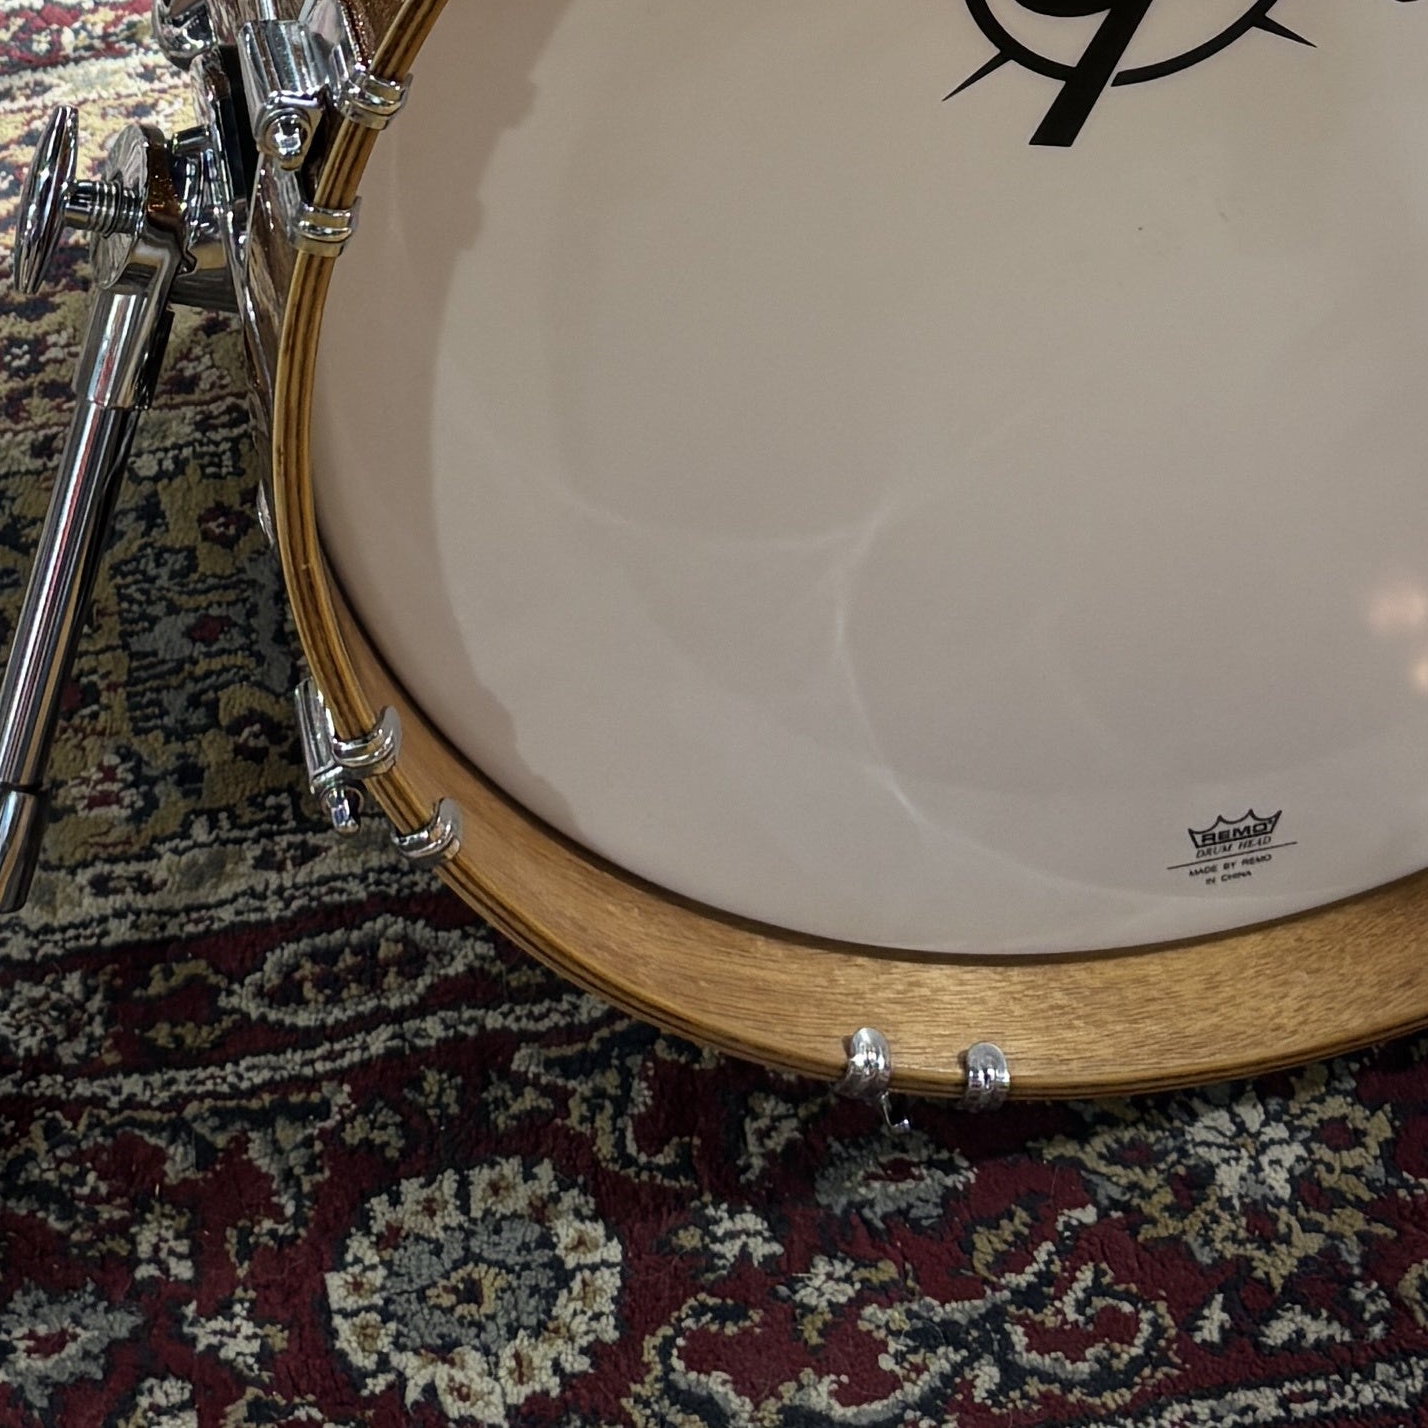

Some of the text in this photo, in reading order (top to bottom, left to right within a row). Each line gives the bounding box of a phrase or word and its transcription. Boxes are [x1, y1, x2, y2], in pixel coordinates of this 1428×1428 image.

[1201, 822, 1268, 844] REMO
[1196, 836, 1272, 858] DRUM HEAD
[1189, 854, 1272, 877] MADE BY REMO
[1206, 870, 1252, 885] IN CHINA
